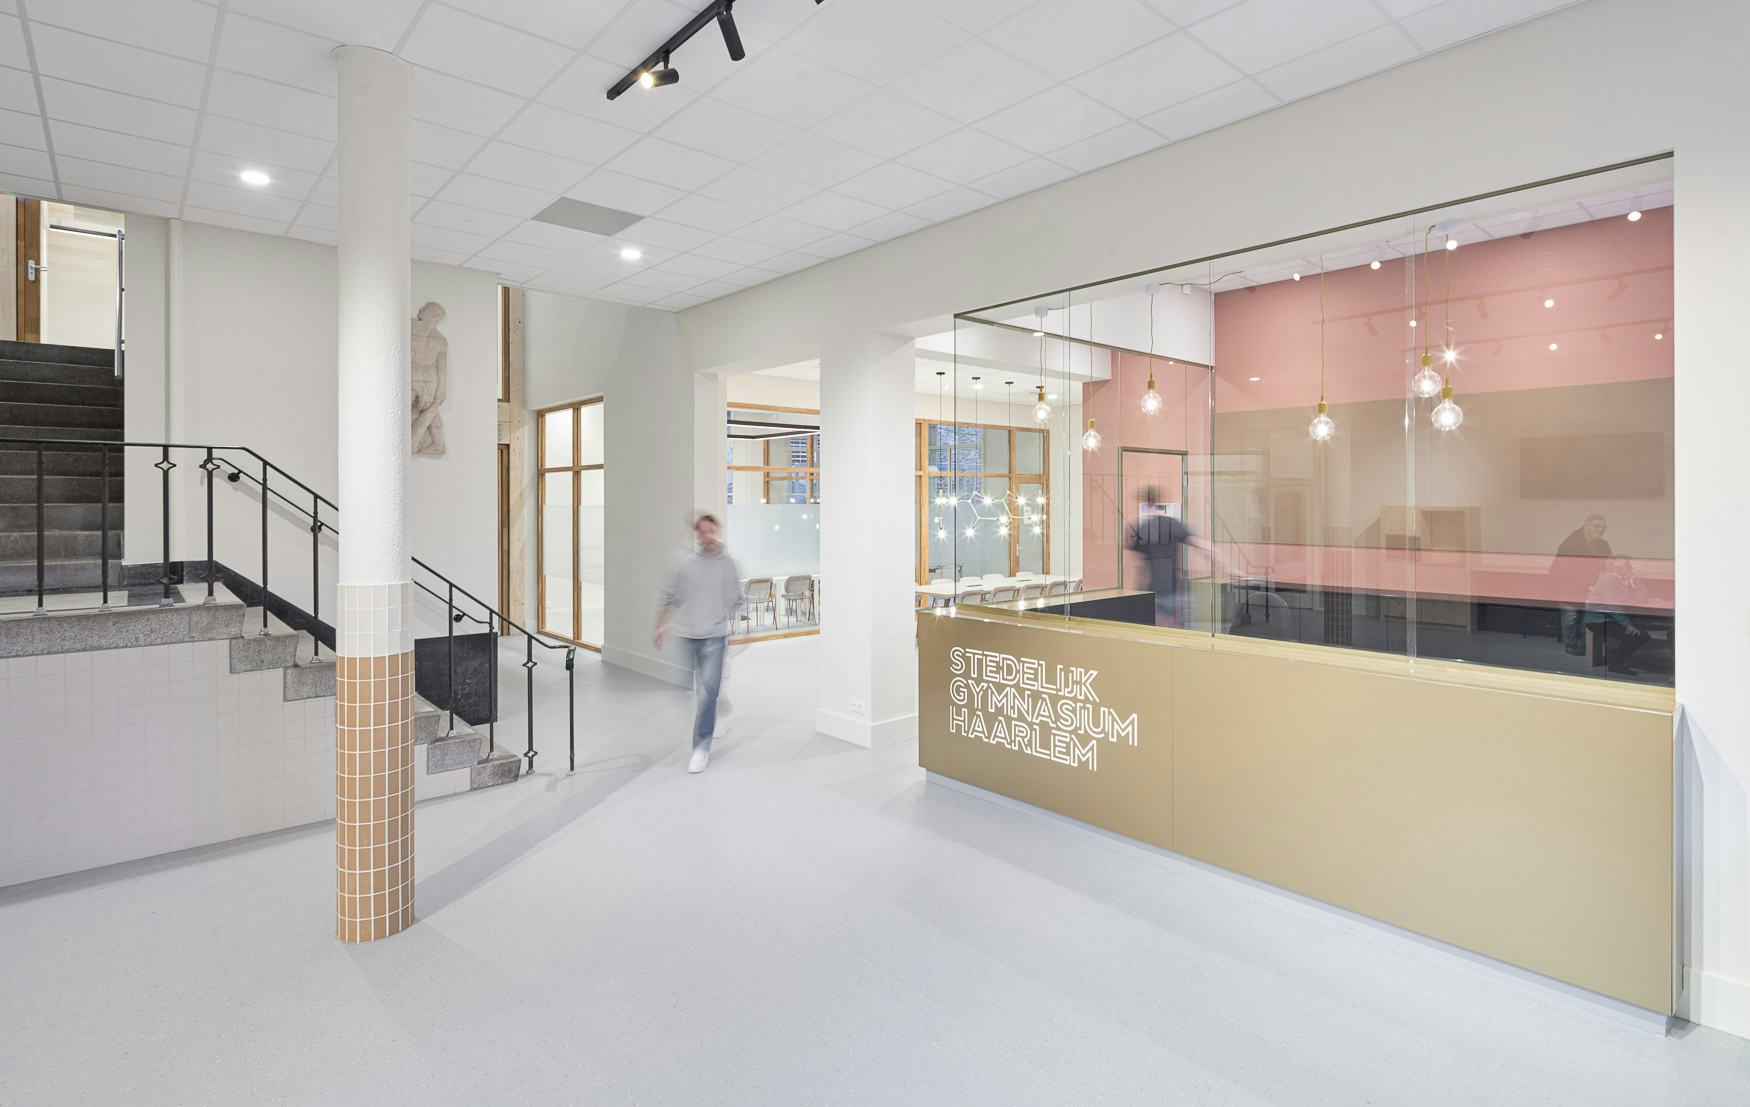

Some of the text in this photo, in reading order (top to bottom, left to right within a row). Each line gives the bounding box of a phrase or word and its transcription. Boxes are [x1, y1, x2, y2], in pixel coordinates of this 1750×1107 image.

[950, 647, 1099, 703] STEDELIJK
[950, 677, 1138, 747] GYMNASIUM
[950, 706, 1097, 771] HAARLEM
